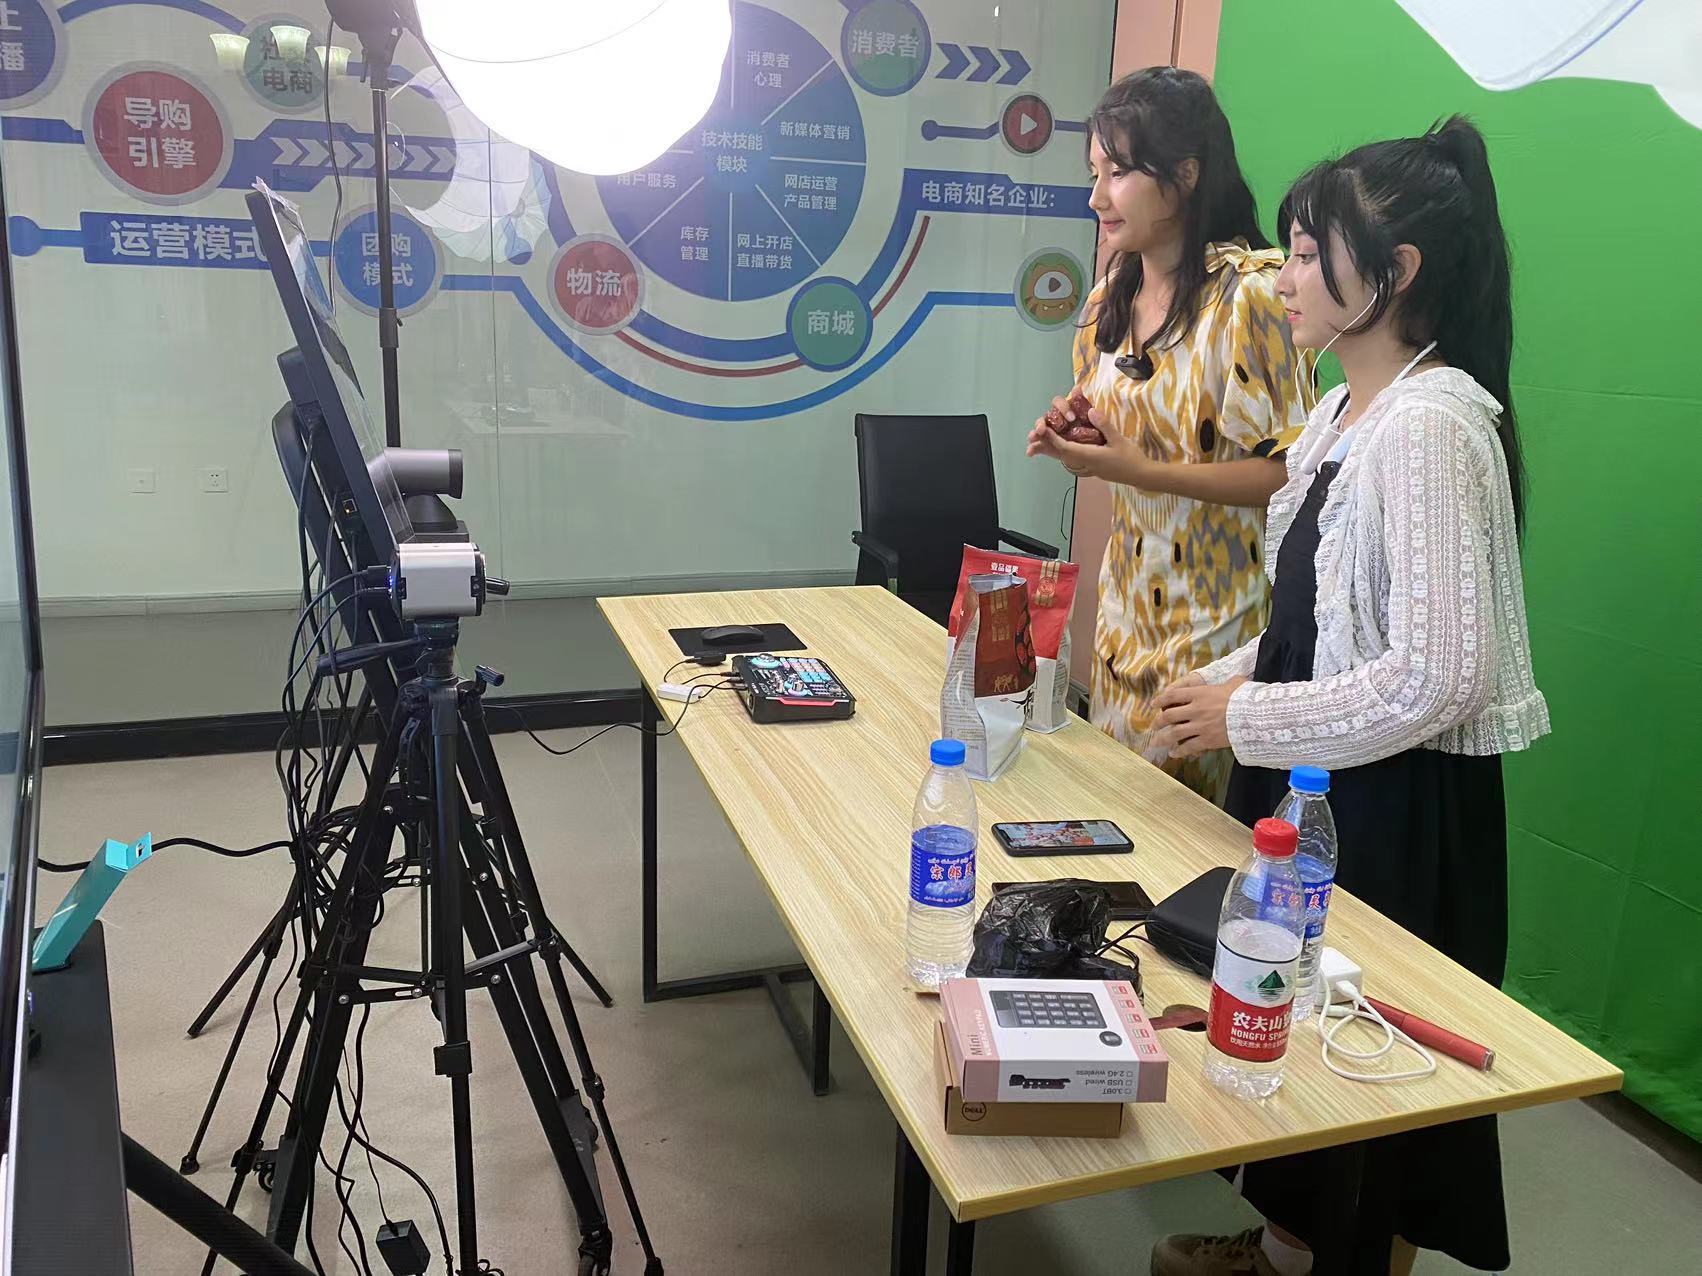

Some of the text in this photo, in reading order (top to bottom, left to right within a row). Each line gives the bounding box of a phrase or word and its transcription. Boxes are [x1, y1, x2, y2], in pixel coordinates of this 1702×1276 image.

[852, 30, 919, 58] 消费者
[746, 50, 791, 69] 消费者
[262, 68, 313, 94] 电商
[754, 71, 783, 88] 心理
[123, 97, 192, 131] 导购
[780, 121, 851, 140] 新媒体营销
[701, 130, 763, 151] 技术技能
[127, 136, 197, 169] 引擎
[716, 154, 748, 173] 模块
[617, 172, 677, 189] 用户服务
[784, 173, 838, 191] 网店运营
[784, 194, 837, 211] 产品管理
[110, 220, 268, 262] 运营模式
[680, 226, 709, 242] 库存
[736, 233, 793, 250] 网上开店
[361, 232, 412, 257] 团购
[680, 246, 709, 262] 管理
[736, 253, 793, 270] 直播带货
[363, 261, 414, 287] 模式
[566, 267, 621, 297] 物流
[807, 309, 856, 336] 商城
[1230, 1027, 1266, 1041] NONGFU
[967, 1034, 983, 1056] Mini
[1076, 1070, 1106, 1078] wireless
